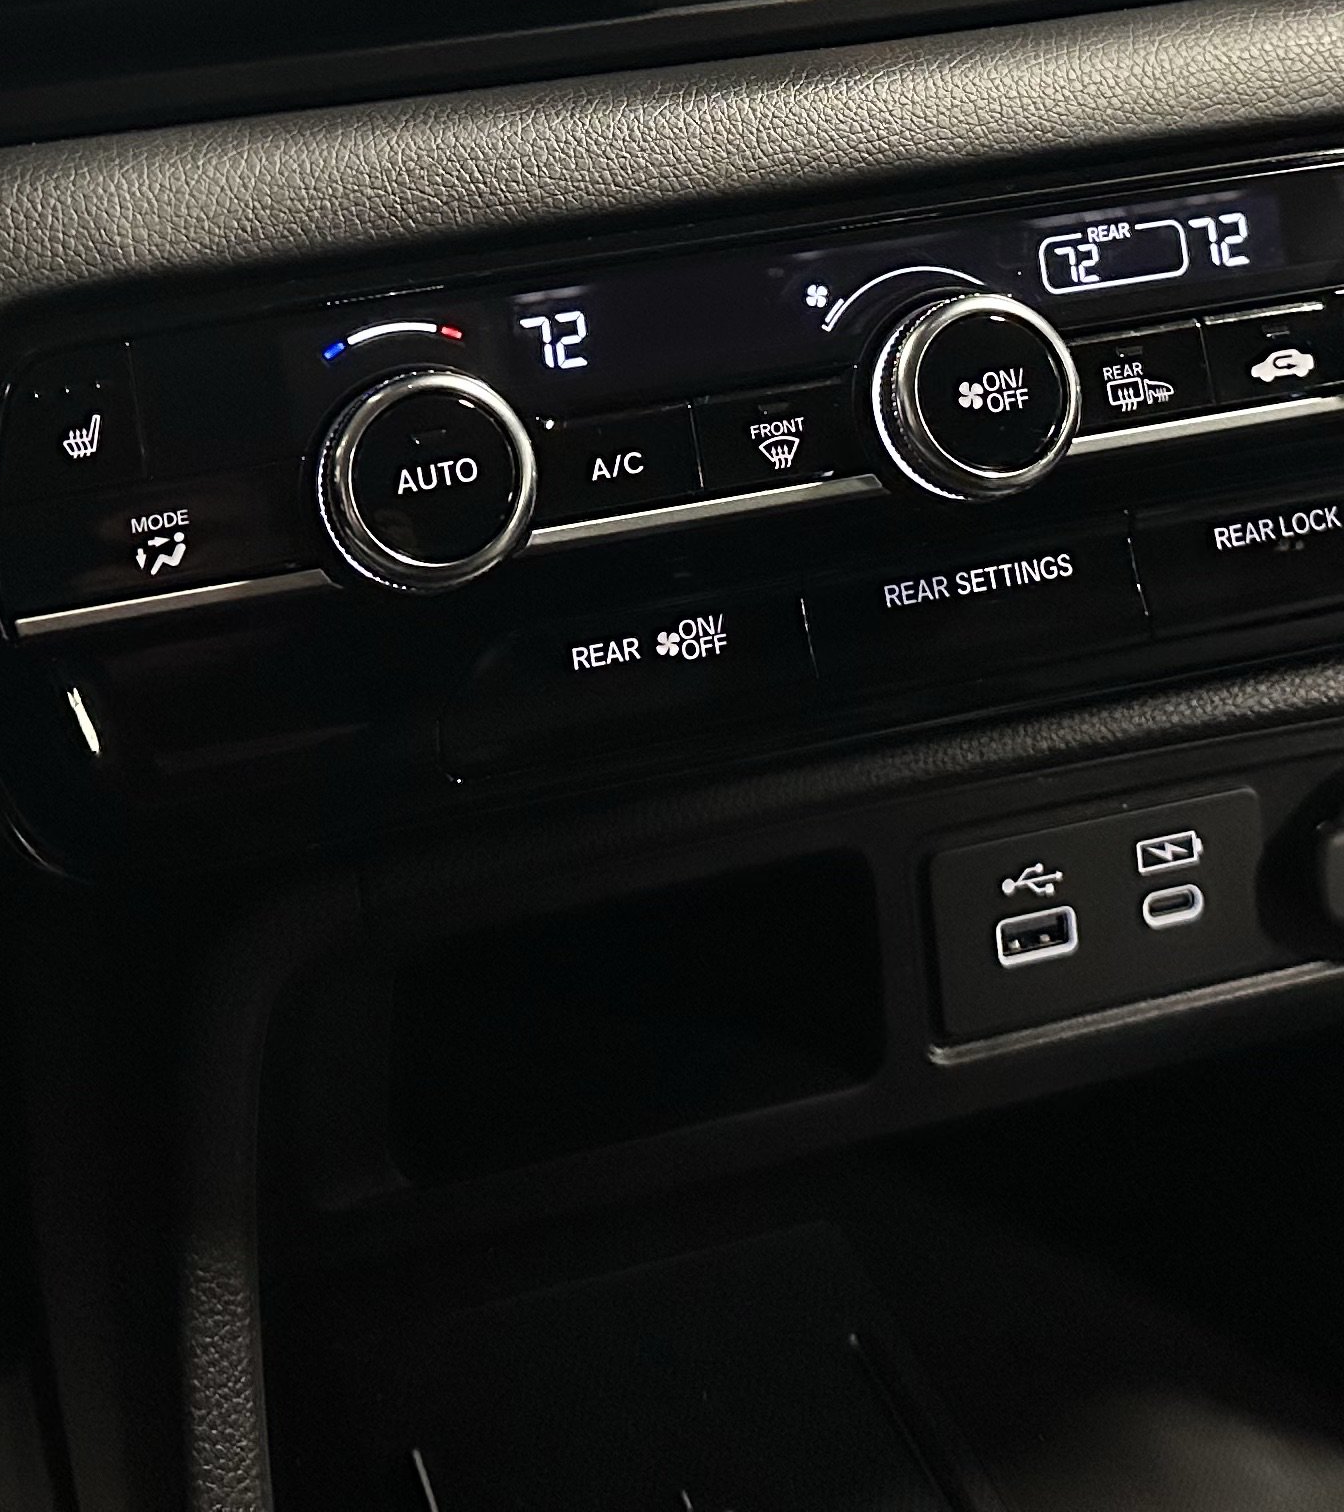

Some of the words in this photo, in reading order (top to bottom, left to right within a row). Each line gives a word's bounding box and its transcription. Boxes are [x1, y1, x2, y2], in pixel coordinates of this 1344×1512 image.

[1086, 221, 1132, 243] REAR
[1187, 212, 1251, 268] 72
[1052, 243, 1100, 285] 72
[519, 310, 588, 370] 72
[981, 367, 1025, 393] ON/
[1102, 361, 1144, 383] REAR
[986, 393, 1030, 414] OFF
[749, 416, 806, 442] FRONT
[397, 457, 478, 495] AUTO
[591, 451, 644, 482] A/C
[130, 509, 190, 534] MODE
[1213, 518, 1276, 550] REAR
[1278, 505, 1342, 537] LOCK
[883, 575, 951, 608] REAR
[955, 553, 1073, 595] SETTINGS
[679, 612, 726, 641] ON/
[571, 637, 641, 671] REAR
[680, 634, 728, 661] OFF
